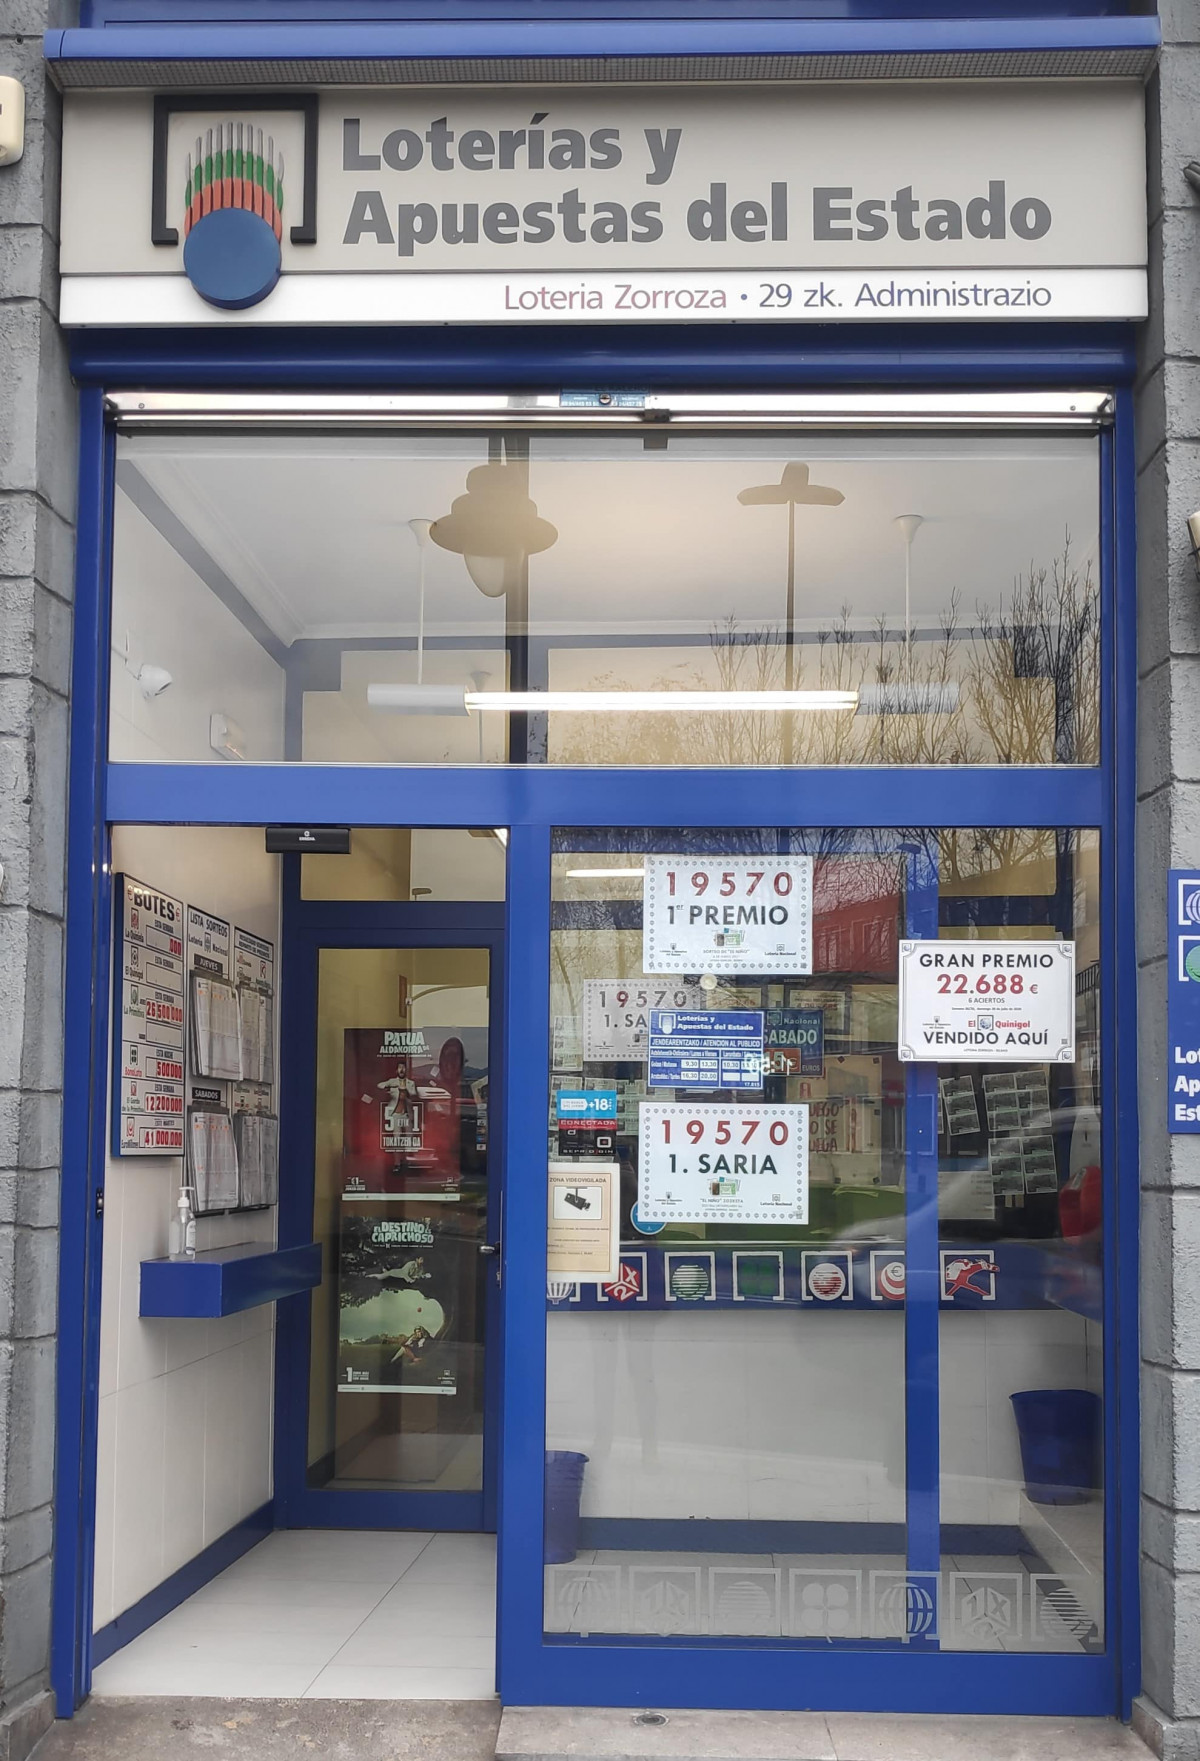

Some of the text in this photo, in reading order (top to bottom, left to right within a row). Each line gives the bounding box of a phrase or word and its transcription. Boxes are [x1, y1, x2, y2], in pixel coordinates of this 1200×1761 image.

[342, 112, 682, 185] Loterías y
[342, 180, 1052, 257] Apuestas del Estado
[505, 283, 603, 310] Loteria
[614, 284, 727, 310] Zorroza
[759, 283, 792, 308] 29
[803, 282, 843, 307] zk.
[854, 281, 1052, 307] Administrazio
[667, 872, 793, 896] 19570
[134, 886, 175, 921] BOTES
[689, 905, 789, 925] PREMIO
[190, 911, 228, 938] LISTA SORTEOS
[200, 958, 218, 971] JUEVES
[919, 953, 1054, 968] GRAN PREMIO
[937, 974, 1039, 995] 22.688 €
[677, 1023, 712, 1031] Apuestas
[968, 1020, 1031, 1030] El Quinigol
[384, 1031, 425, 1046] PATUA
[923, 1029, 1049, 1046] VENDIDO AQUÍ
[195, 1089, 218, 1100] SABADOS
[588, 1098, 609, 1111] +18
[809, 1101, 839, 1117] UEGO
[384, 1105, 394, 1131] 5
[412, 1105, 420, 1132] 1
[662, 1119, 789, 1146] 19570
[809, 1137, 838, 1153] UEGA
[669, 1153, 778, 1175] 1. SARIA
[381, 1221, 425, 1234] DESTINO
[371, 1232, 434, 1244] CAPRICHOSO
